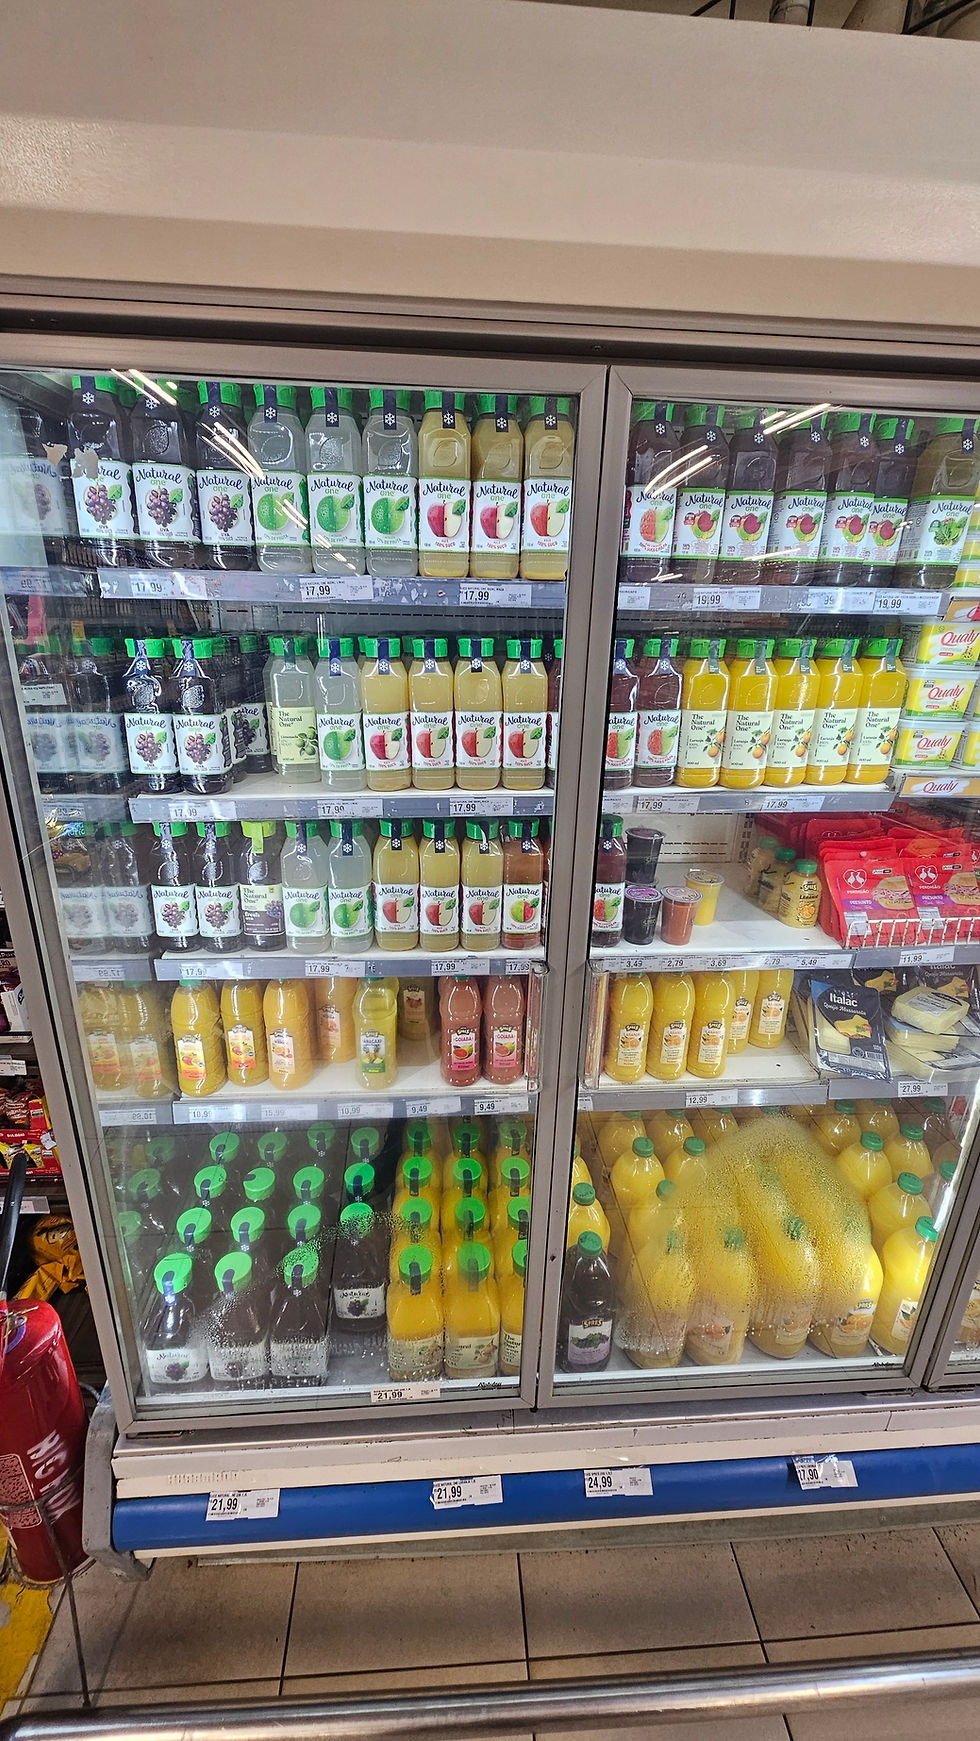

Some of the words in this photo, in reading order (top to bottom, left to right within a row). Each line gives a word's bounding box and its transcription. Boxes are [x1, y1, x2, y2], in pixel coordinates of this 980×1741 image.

[135, 467, 182, 483] Natural
[199, 475, 243, 489] Natural
[251, 475, 293, 489] Natural
[311, 478, 354, 492] Natural
[366, 480, 409, 494] Natural
[423, 481, 465, 497] Natural
[476, 484, 518, 499] Natural
[527, 482, 570, 496] Natural
[685, 492, 724, 507] Natural
[731, 496, 772, 510] Natural
[788, 496, 826, 510] Natural
[872, 502, 907, 516] Natural
[932, 502, 973, 515] Natural
[135, 581, 163, 593] 1799
[305, 585, 331, 597] 17,99
[463, 590, 490, 602] 17,99
[696, 594, 721, 605] 19,99
[878, 597, 903, 608] 19,99
[941, 630, 980, 646] Qualy
[928, 684, 965, 700] Qualy
[127, 713, 166, 729] Natural
[175, 714, 216, 730] Natural
[319, 716, 355, 728] Natural
[365, 715, 401, 728] Natural
[412, 713, 448, 726] Natural
[458, 713, 495, 726] Natural
[505, 714, 542, 726] Natural
[608, 716, 635, 727] atural
[644, 713, 680, 725] Natural
[917, 735, 952, 750] Qualy
[923, 779, 958, 793] Qualy
[453, 803, 476, 812] 17,99
[640, 801, 663, 810] 17,99
[766, 800, 788, 809] 17,99
[153, 888, 190, 899] Natural
[197, 888, 233, 899] Natural
[285, 890, 320, 900] Natural
[330, 890, 363, 900] Natural
[379, 885, 414, 897] Natural
[422, 889, 456, 899] Natural
[465, 888, 500, 899] Natural
[506, 887, 540, 897] Natural
[595, 885, 621, 896] atural
[626, 960, 643, 968] 3,49
[667, 959, 684, 967] 2,79
[711, 959, 727, 967] 3,69
[903, 955, 923, 963] 11,99
[308, 965, 331, 973] 17,99
[434, 962, 456, 971] 17,99
[830, 993, 858, 1007] Italac
[902, 1083, 921, 1092] 27,99
[479, 1102, 495, 1110] 9,49
[688, 1096, 707, 1105] 12,99
[411, 1105, 428, 1113] 9,49
[377, 1390, 402, 1400] 21,99
[588, 1476, 612, 1489] 24,99
[437, 1485, 462, 1500] 21,99
[211, 1497, 238, 1512] 21,99
